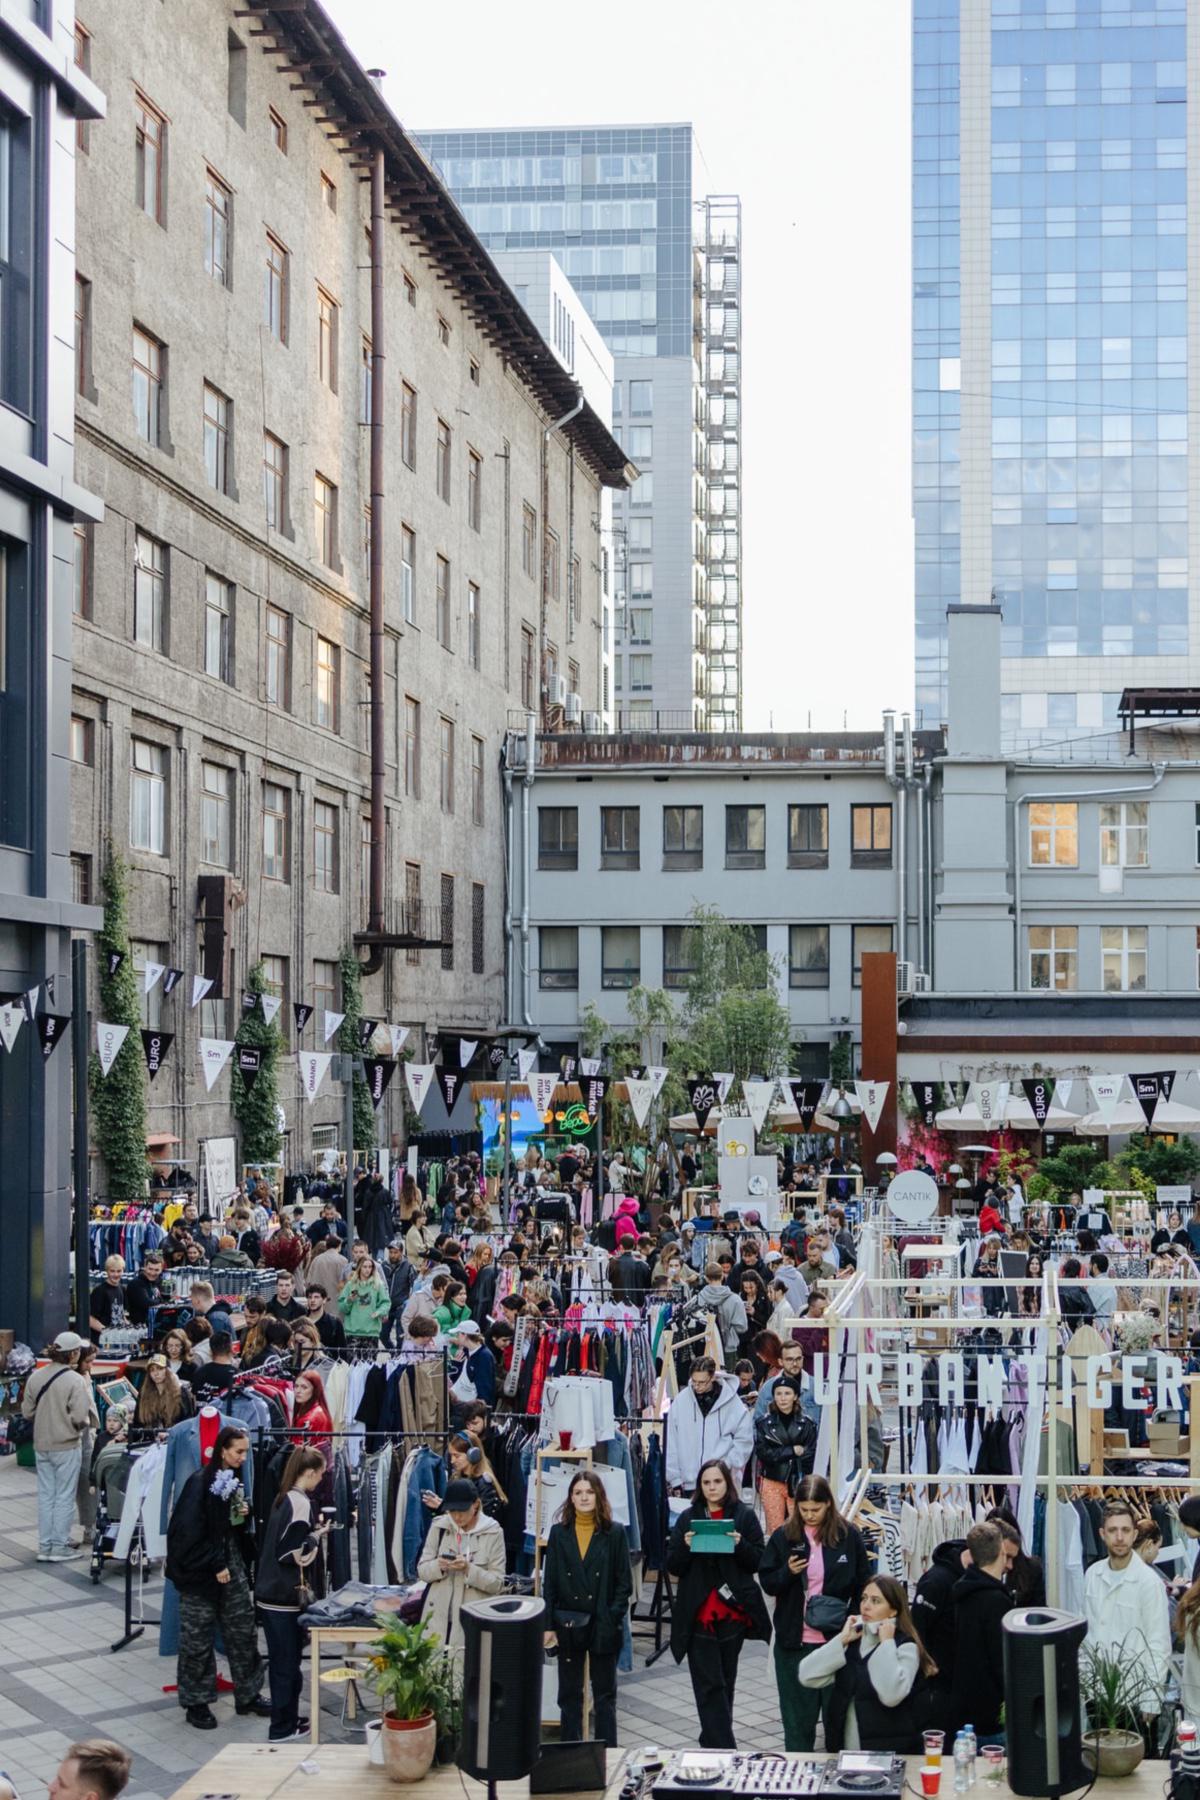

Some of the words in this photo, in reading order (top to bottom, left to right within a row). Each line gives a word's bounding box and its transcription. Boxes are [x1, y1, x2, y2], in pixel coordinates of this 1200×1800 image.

[46, 1018, 56, 1036] VOW
[43, 1042, 52, 1054] the
[149, 1036, 161, 1070] BURO.
[207, 1049, 221, 1058] Sm
[241, 1055, 256, 1064] Sm
[544, 1080, 551, 1093] sm
[596, 1081, 604, 1097] sm
[1098, 1087, 1113, 1095] Sm
[1139, 1085, 1154, 1093] Sm
[536, 1078, 545, 1112] market
[588, 1080, 598, 1116] market
[868, 1089, 877, 1105] VOW
[924, 1086, 933, 1105] VOW
[1034, 1082, 1046, 1119] BURO.
[982, 1089, 991, 1119] BURO
[893, 1191, 931, 1201] CANTIK
